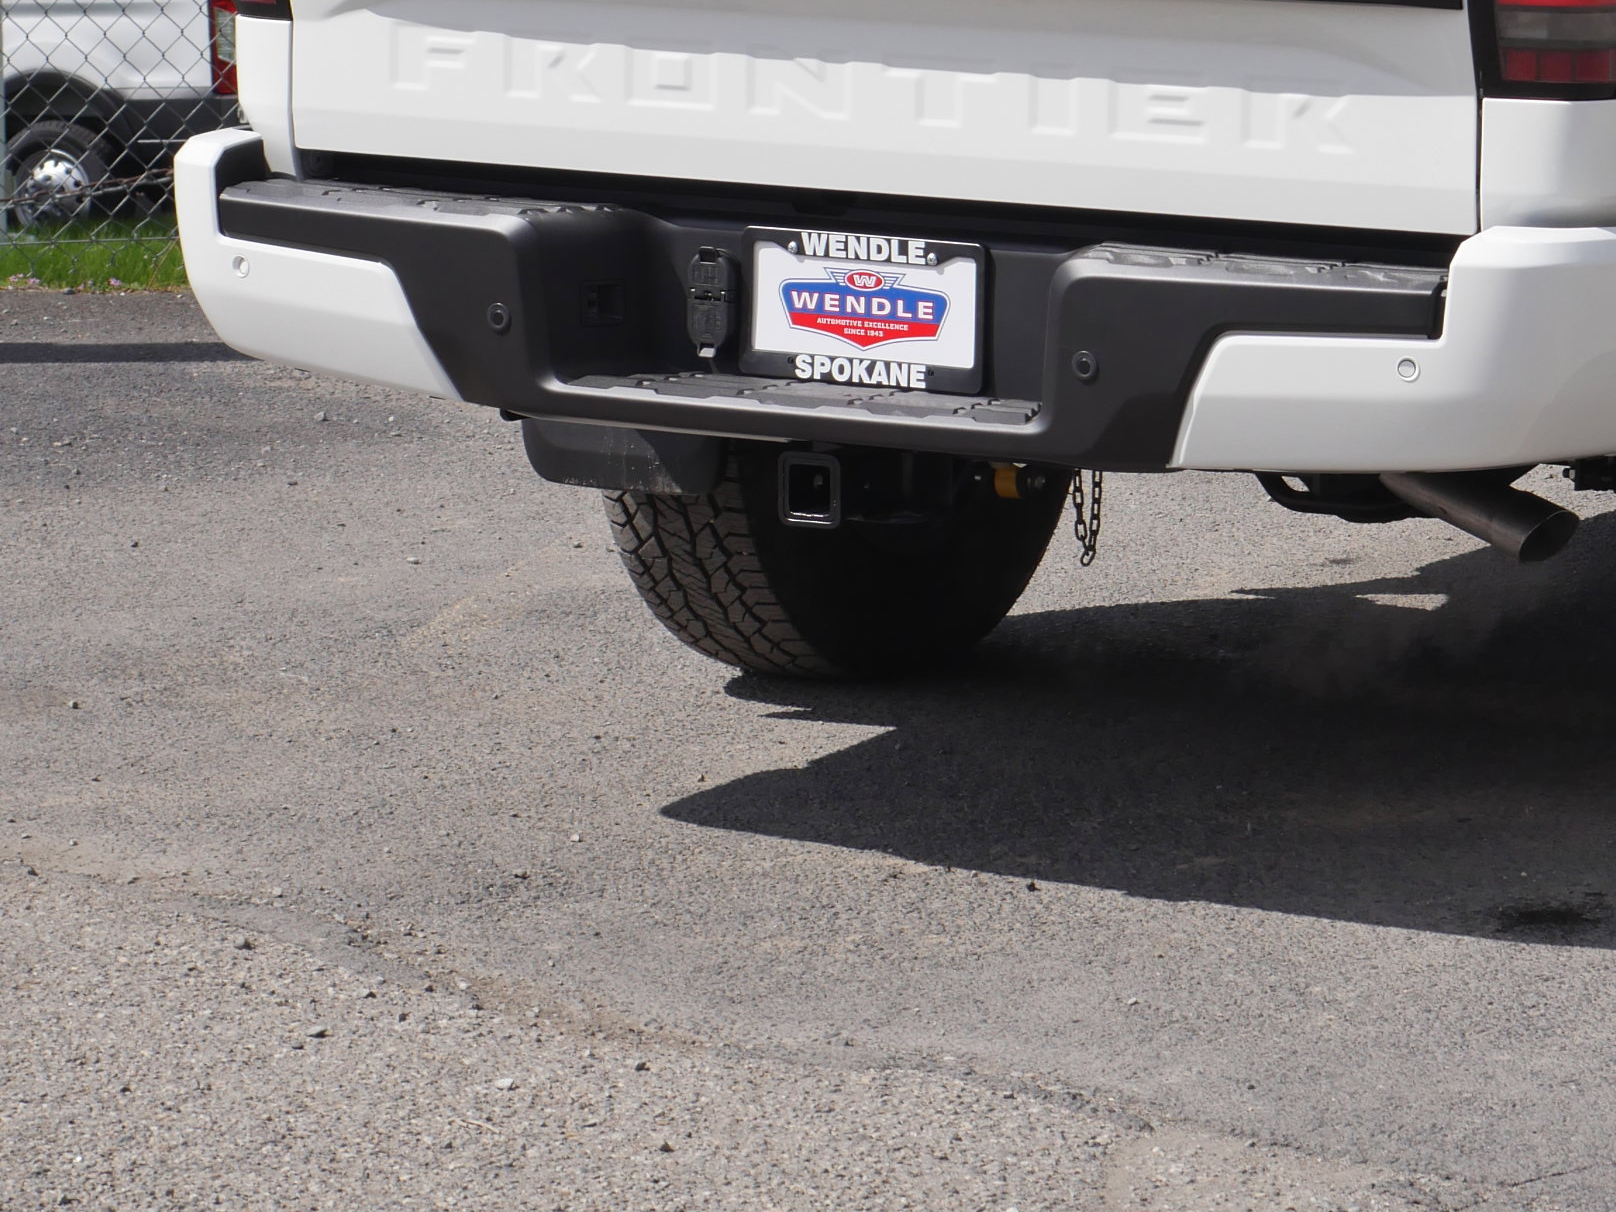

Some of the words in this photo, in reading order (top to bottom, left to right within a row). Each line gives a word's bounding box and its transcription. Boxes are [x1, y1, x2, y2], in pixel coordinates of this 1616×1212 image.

[391, 17, 1353, 154] FRONTIER
[801, 232, 926, 265] WENDLE
[790, 290, 933, 320] WENDLE
[816, 317, 862, 327] AUTOMOTIVE
[864, 321, 908, 331] EXCELLENCE
[795, 354, 927, 388] SPOKANE
